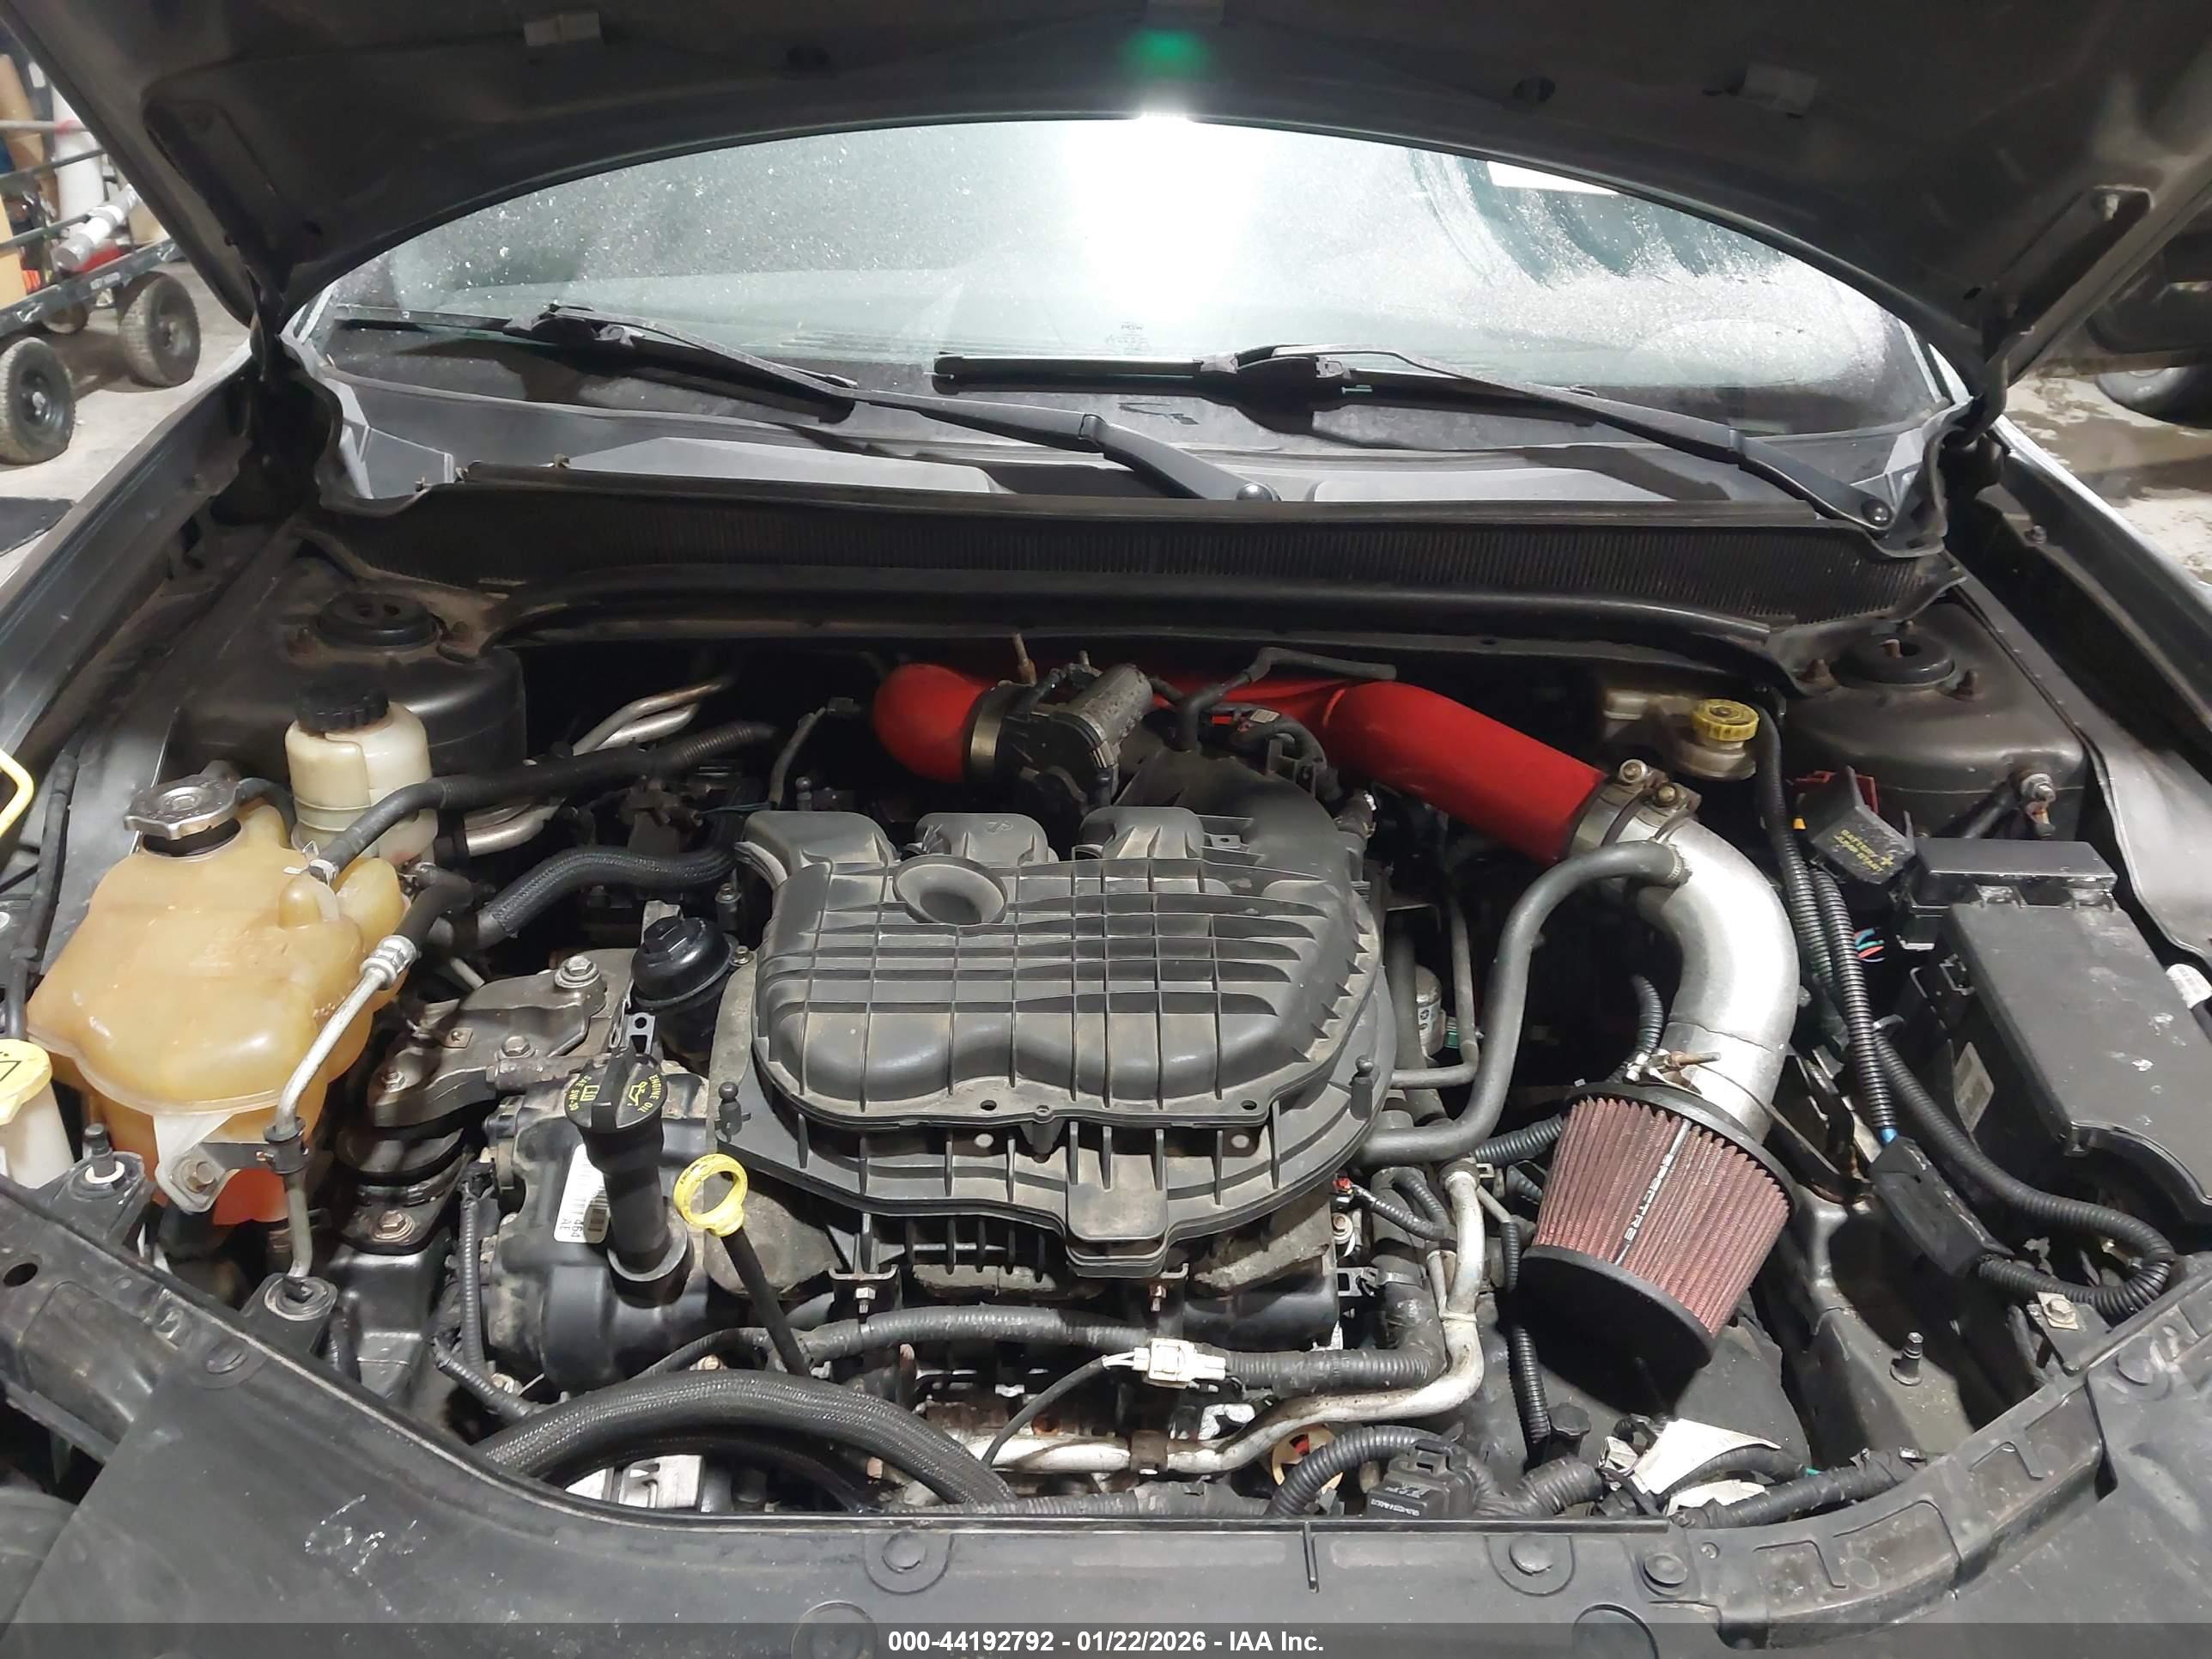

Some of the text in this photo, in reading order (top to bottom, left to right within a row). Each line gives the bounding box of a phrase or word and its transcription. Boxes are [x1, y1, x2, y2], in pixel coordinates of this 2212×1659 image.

[1834, 836, 1884, 872] JUMP START
[568, 1075, 592, 1111] SAE 5W-30
[637, 1074, 661, 1113] ENGINE OIL
[1624, 1153, 1674, 1241] SPECTRE
